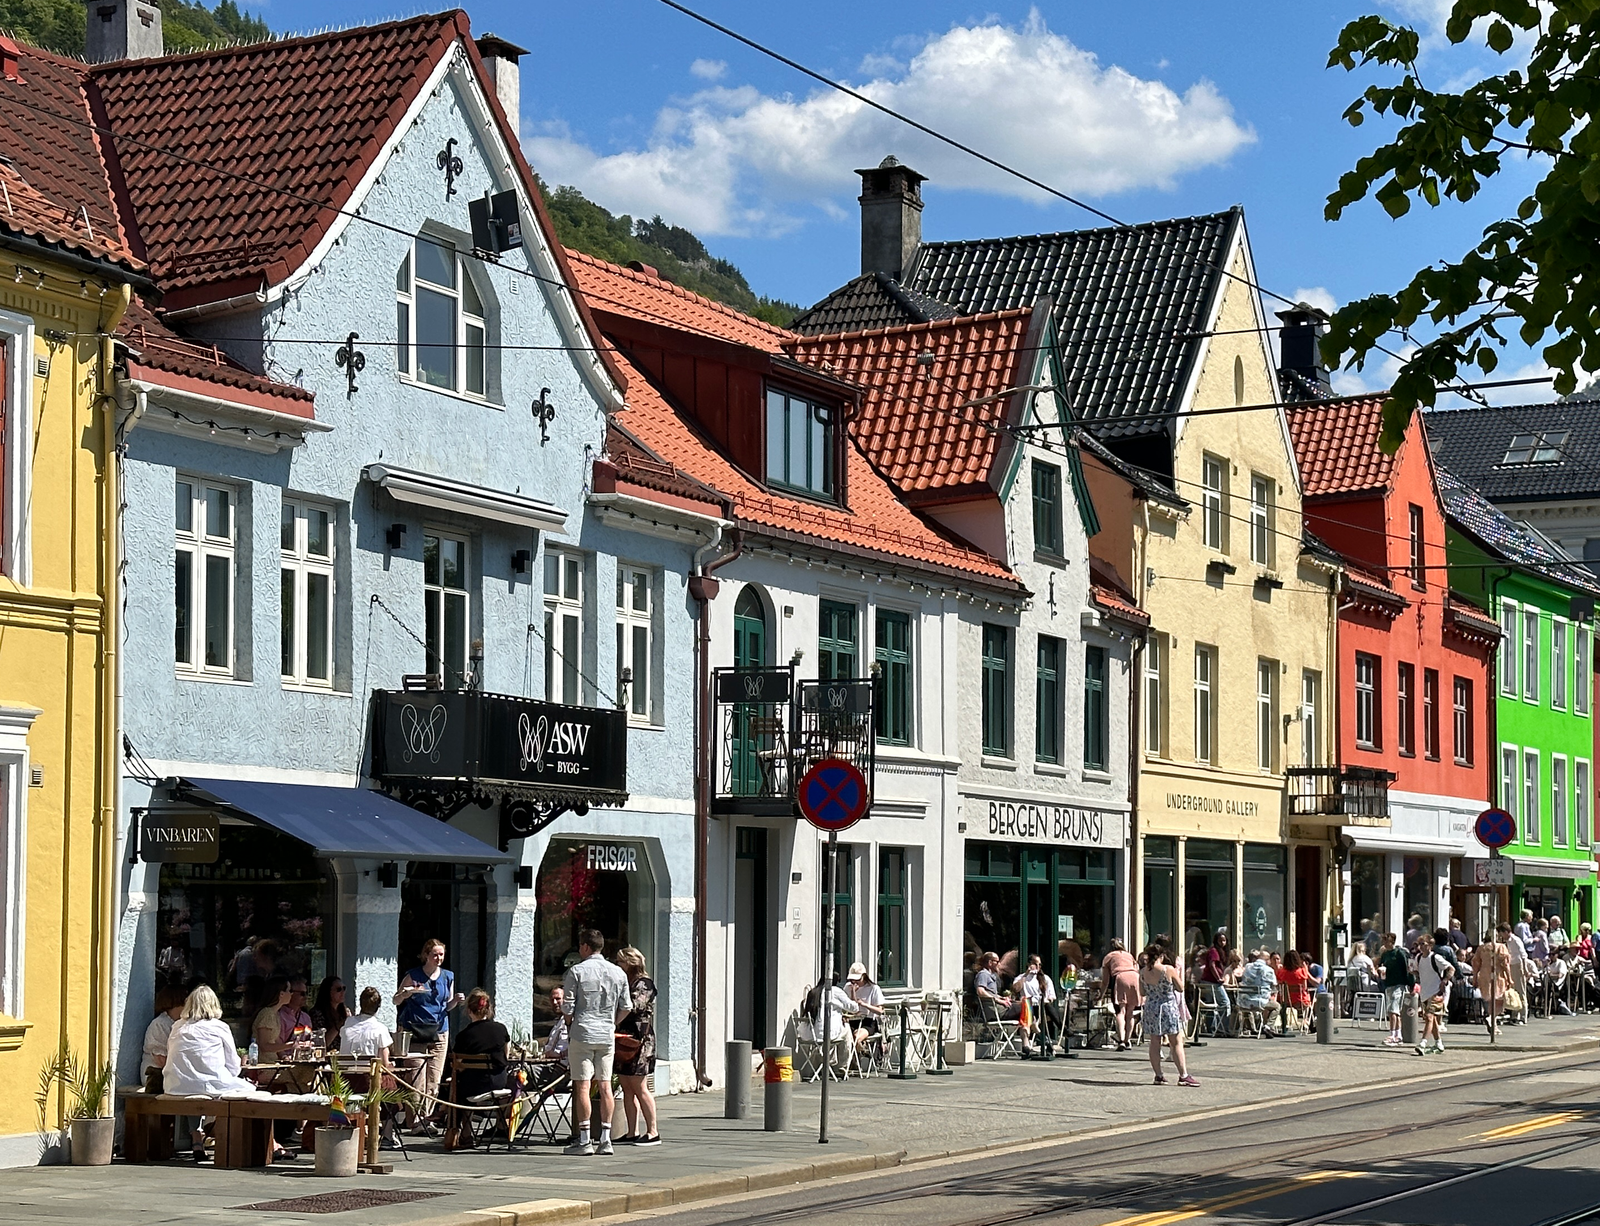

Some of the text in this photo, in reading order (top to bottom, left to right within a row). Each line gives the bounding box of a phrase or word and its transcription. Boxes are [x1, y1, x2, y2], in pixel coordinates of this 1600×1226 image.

[547, 721, 591, 756] ASW
[557, 761, 580, 775] BYGG
[1166, 792, 1259, 817] UNDERGROUND GALLERY
[989, 801, 1048, 838] BERGEN
[146, 827, 216, 843] VINBAREN
[586, 844, 638, 872] FRISØR
